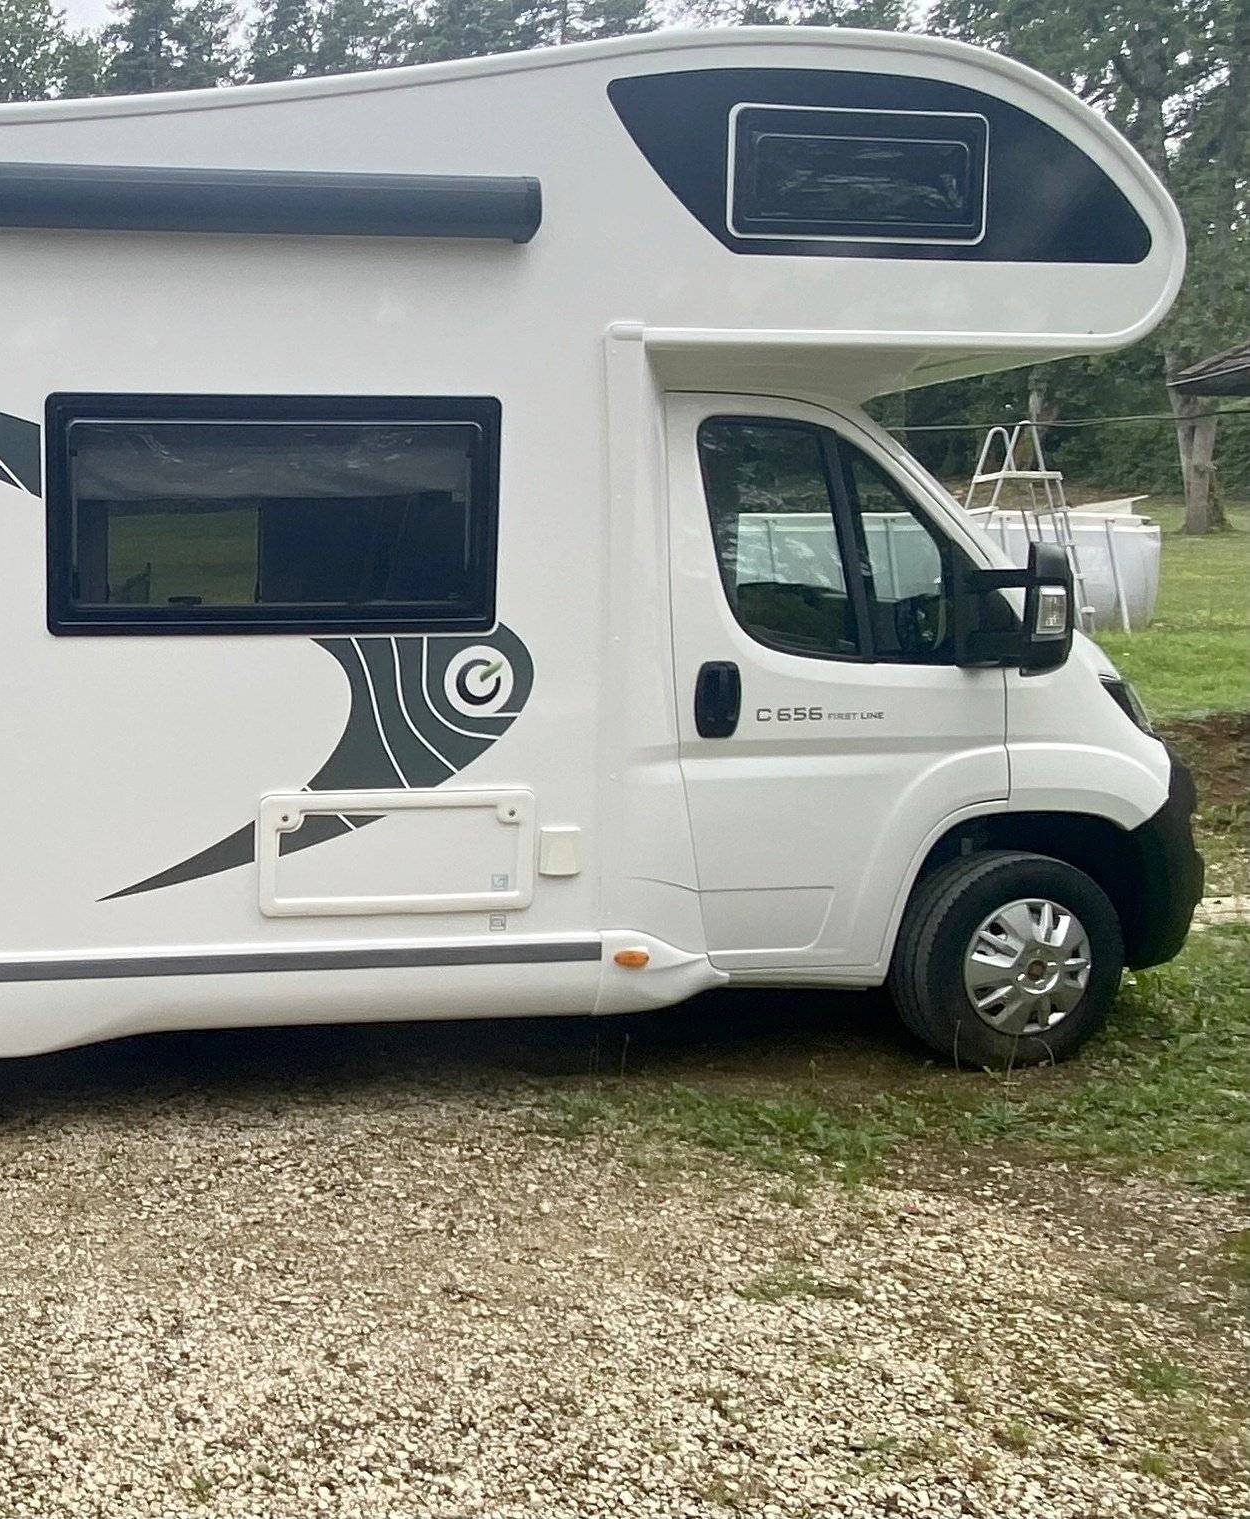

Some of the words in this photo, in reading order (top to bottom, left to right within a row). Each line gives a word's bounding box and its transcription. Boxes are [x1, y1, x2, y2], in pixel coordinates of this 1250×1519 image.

[756, 708, 772, 722] C
[777, 707, 823, 722] 656
[828, 712, 858, 720] FIRST
[860, 711, 885, 720] LINE
